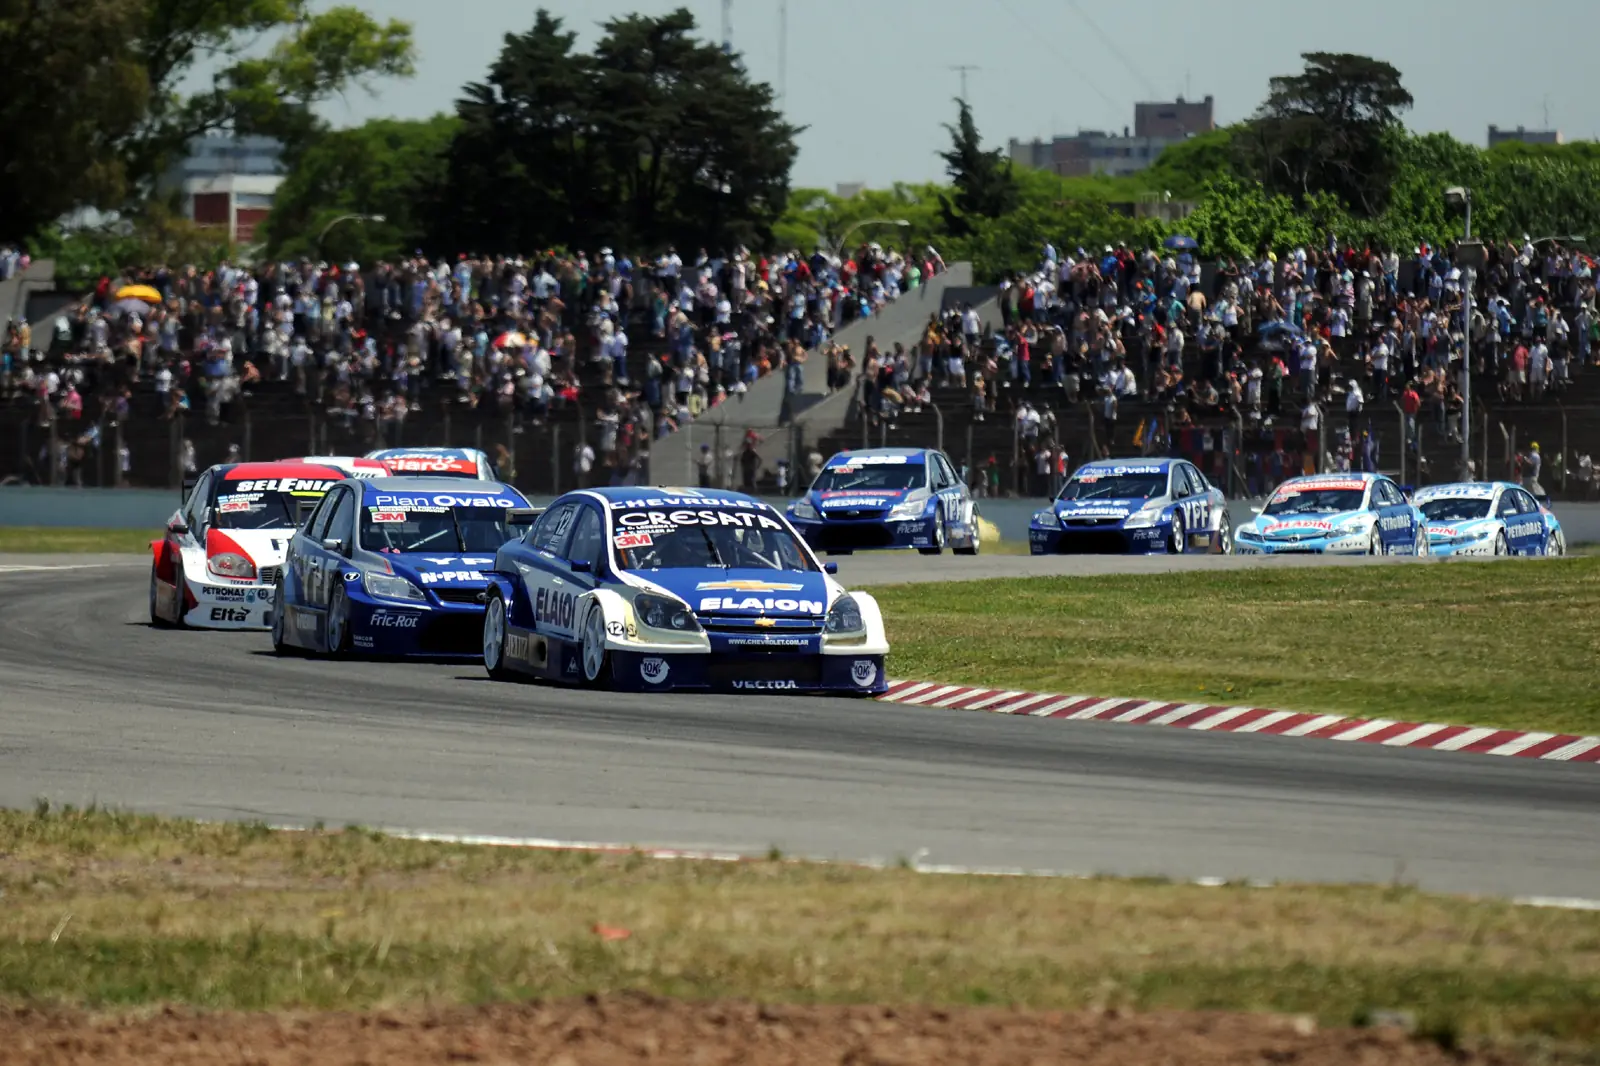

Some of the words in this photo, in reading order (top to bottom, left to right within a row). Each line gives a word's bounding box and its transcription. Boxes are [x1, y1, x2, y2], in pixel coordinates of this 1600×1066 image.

[222, 502, 249, 511] 3M
[375, 495, 429, 506] Plan
[433, 495, 515, 507] Ovalo
[610, 498, 769, 510] CHEVROLET
[374, 512, 404, 520] 3M
[619, 510, 782, 530] CRESATA
[1180, 500, 1208, 529] YPF
[1263, 520, 1332, 534] PALADINI
[617, 535, 651, 546] 3M
[203, 587, 245, 597] PETRONAS
[700, 598, 823, 614] ELAION
[211, 608, 248, 622] Elta
[370, 614, 418, 628] Fric-Rot
[608, 622, 623, 636] 12
[728, 638, 809, 646] WWW.CHEVROLET.COM.AR
[732, 680, 799, 689] VECTRA
